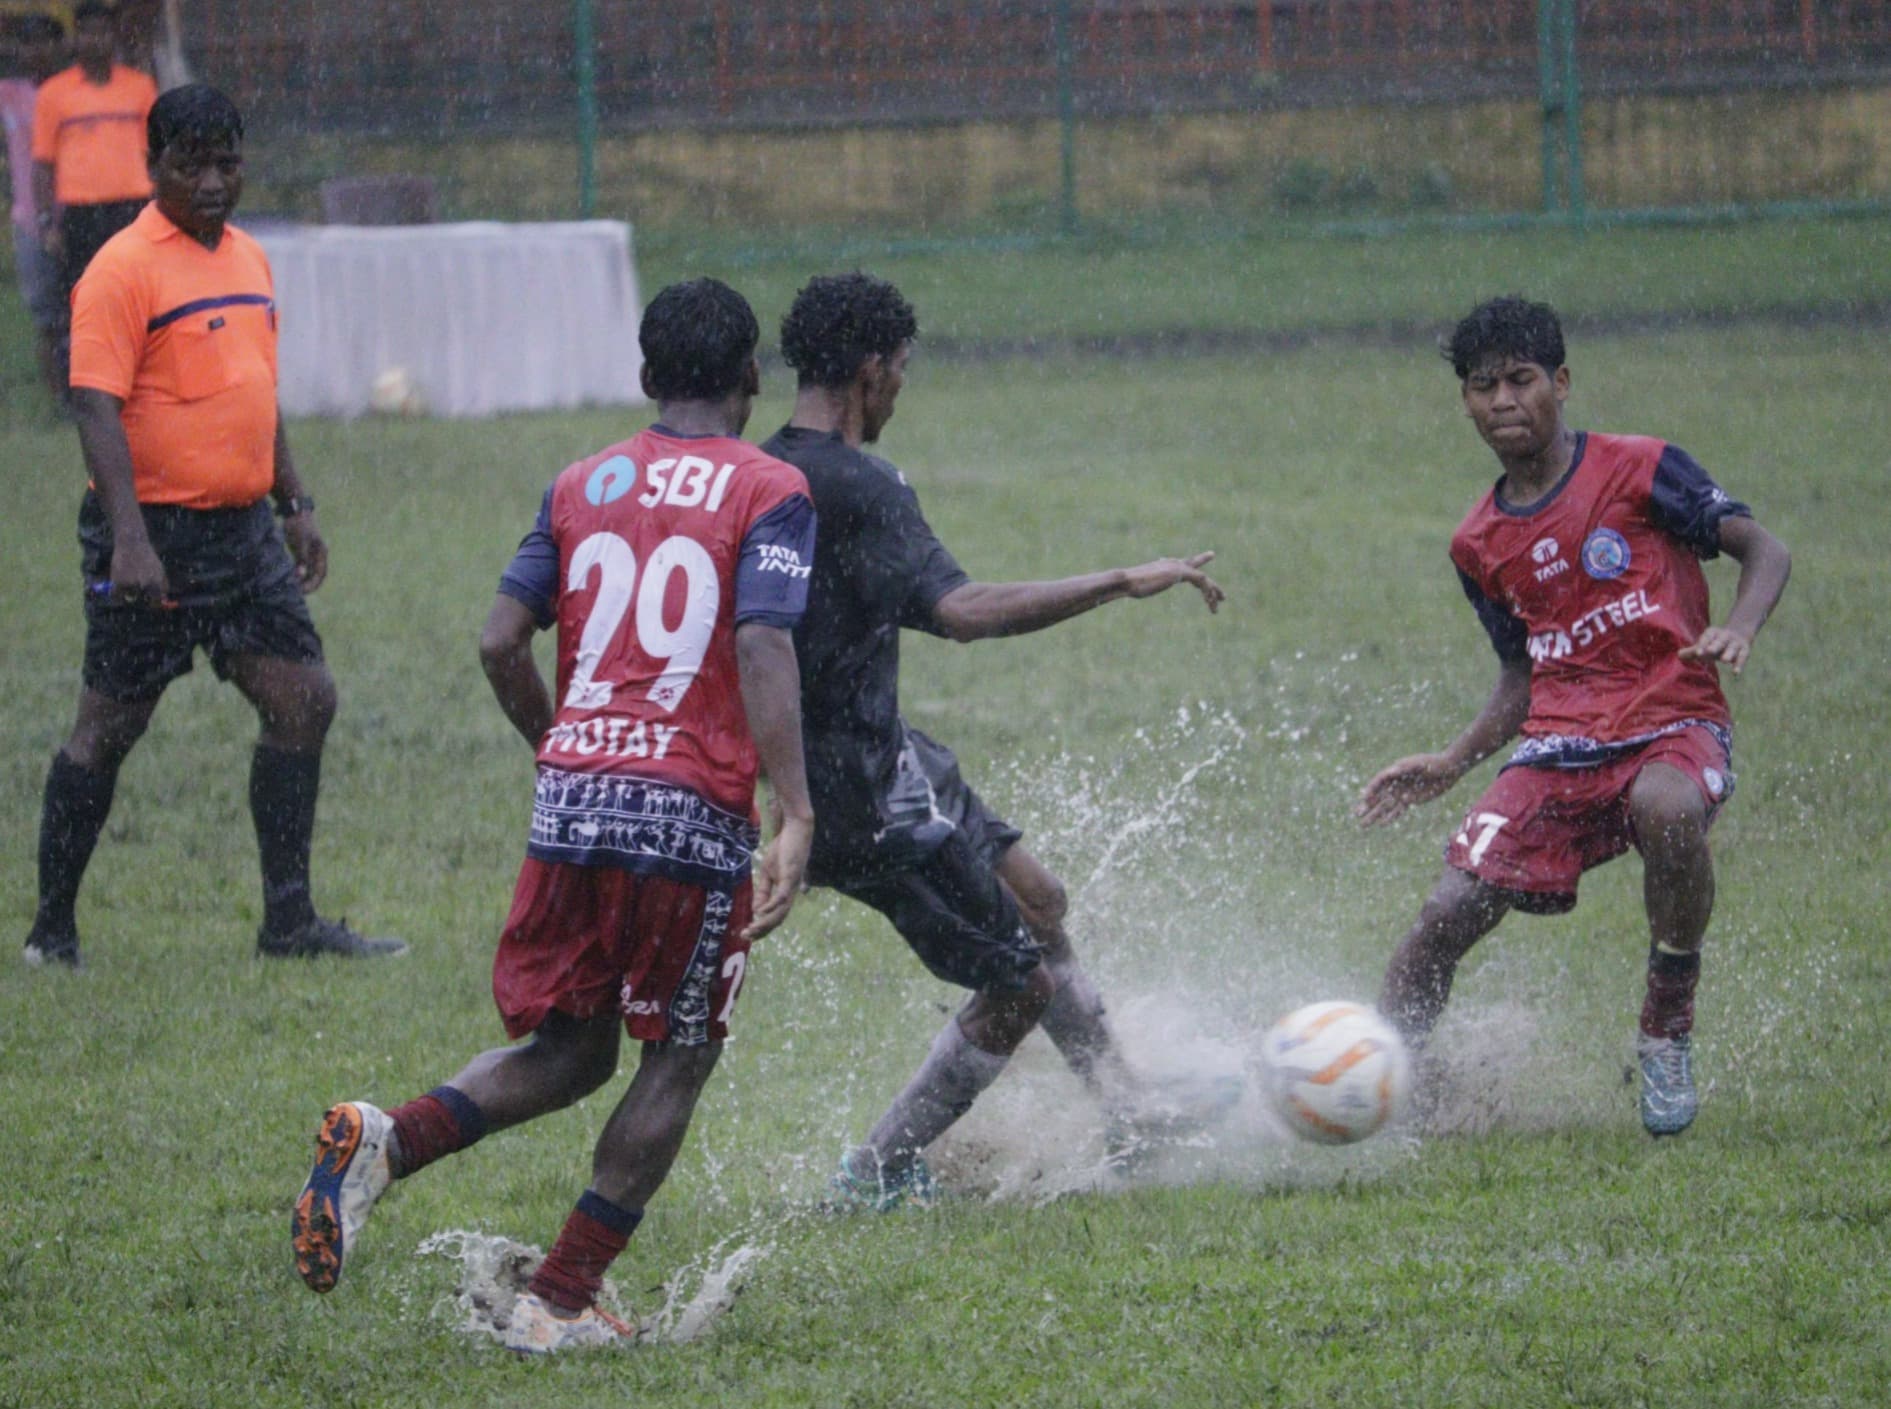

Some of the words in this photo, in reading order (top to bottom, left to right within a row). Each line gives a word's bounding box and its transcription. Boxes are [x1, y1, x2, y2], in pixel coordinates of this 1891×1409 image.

[637, 455, 736, 512] SBI
[756, 543, 800, 565] TATA
[1534, 557, 1570, 583] TATA
[563, 531, 720, 712] 29
[1571, 589, 1661, 646] STEEL
